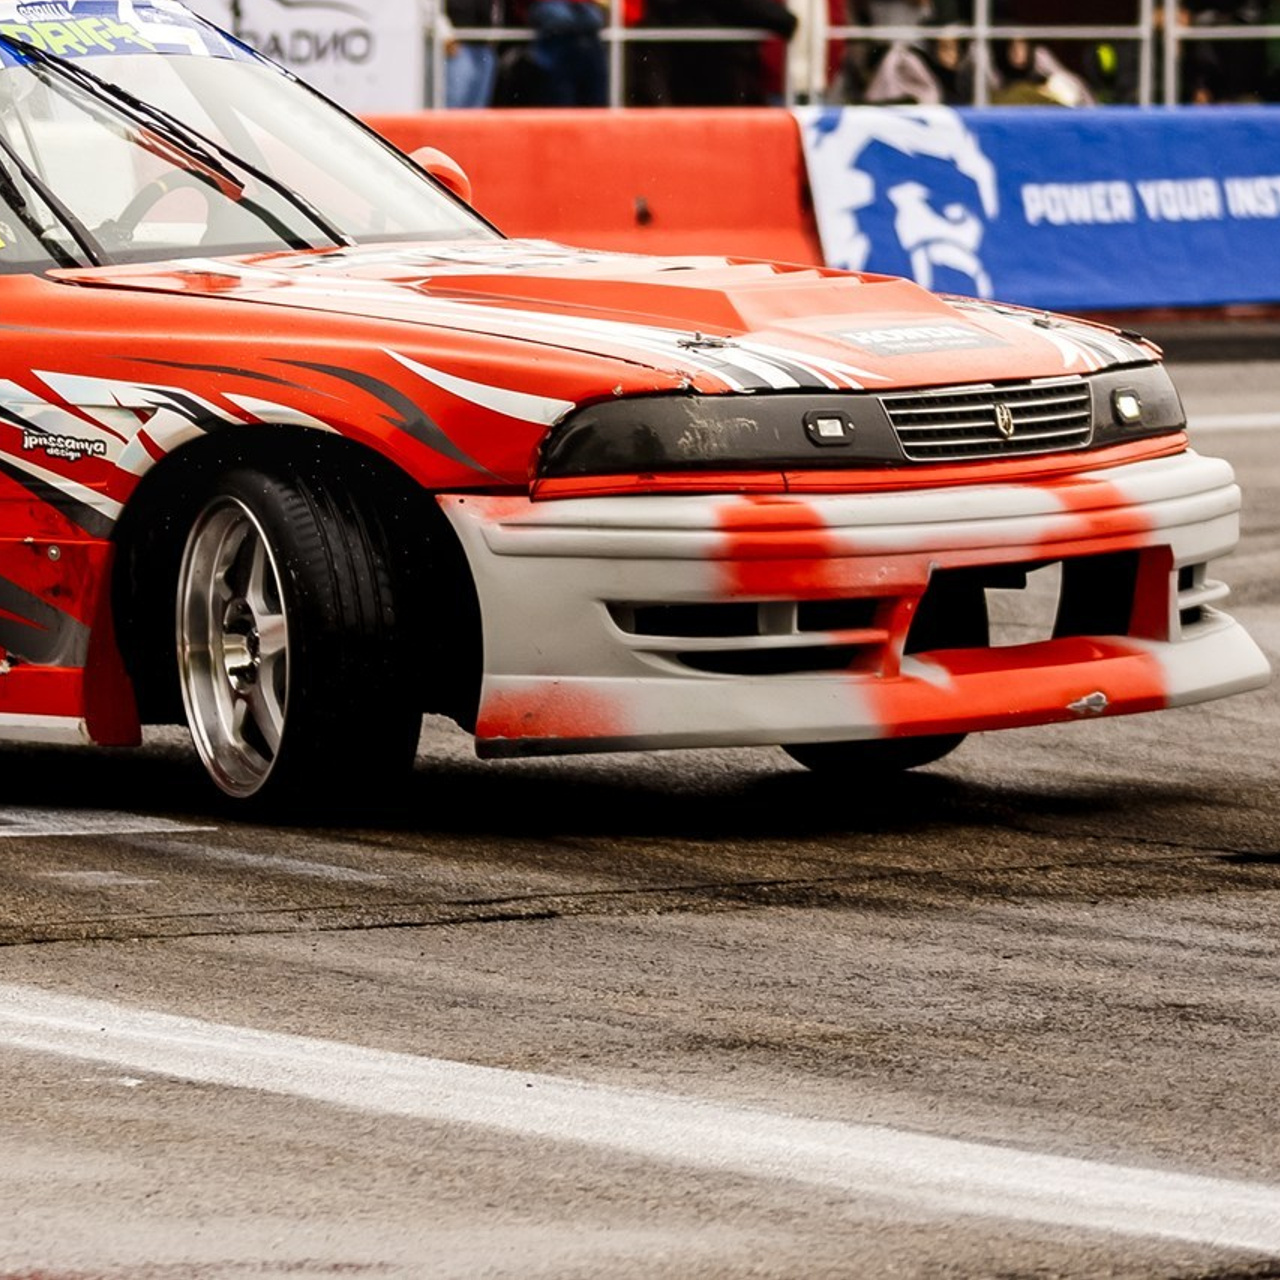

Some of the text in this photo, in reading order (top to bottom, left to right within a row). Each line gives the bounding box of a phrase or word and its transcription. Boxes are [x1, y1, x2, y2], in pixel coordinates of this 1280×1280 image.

[1022, 180, 1136, 227] POWER
[1136, 177, 1222, 222] YOUR
[46, 447, 81, 460] design
